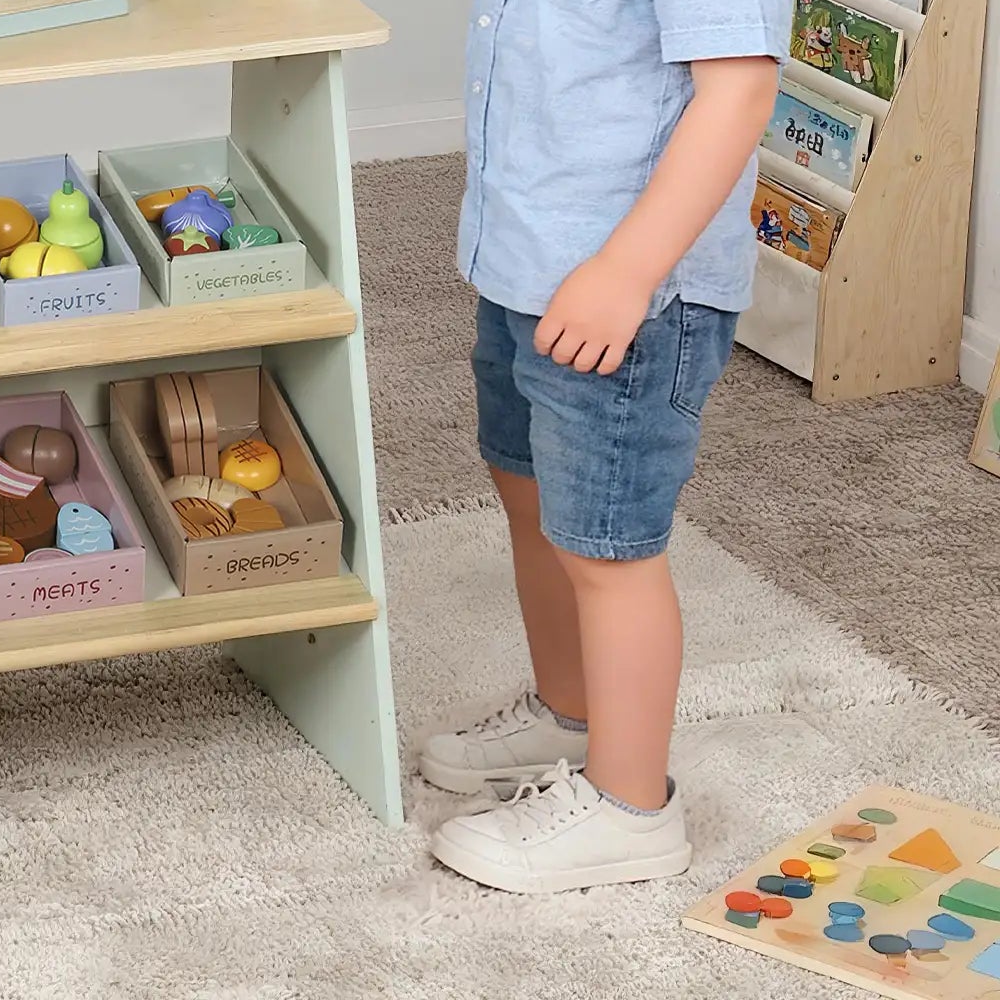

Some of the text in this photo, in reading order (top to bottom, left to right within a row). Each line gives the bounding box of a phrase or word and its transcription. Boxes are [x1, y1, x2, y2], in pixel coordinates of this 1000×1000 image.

[197, 271, 282, 290] VEGETABLES
[40, 292, 106, 312] FRUITS
[226, 551, 300, 574] BREADS
[33, 579, 101, 602] MEATS
